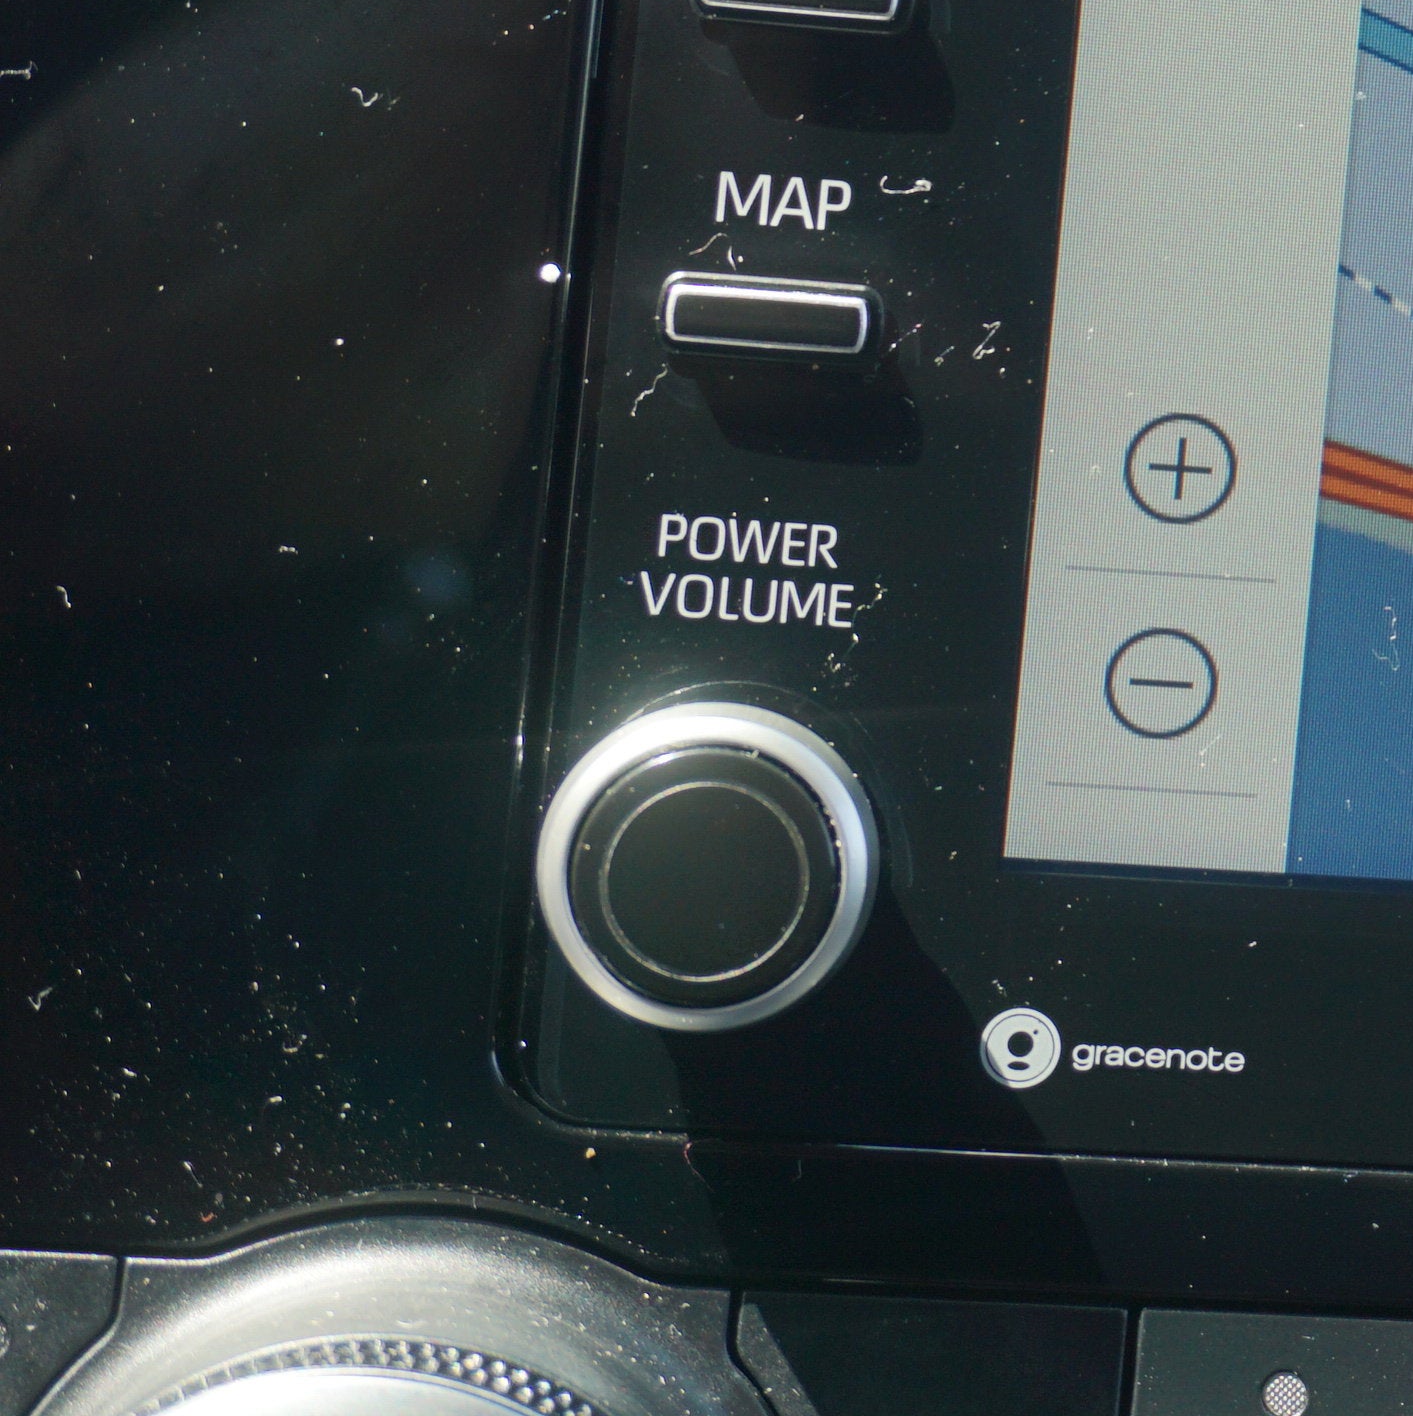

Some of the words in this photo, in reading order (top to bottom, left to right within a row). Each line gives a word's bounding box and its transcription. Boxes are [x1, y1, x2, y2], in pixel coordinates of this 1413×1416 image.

[714, 171, 852, 231] MAP
[656, 512, 839, 570] POWER
[640, 570, 854, 628] VOLUME
[1071, 1040, 1246, 1073] gracenote
